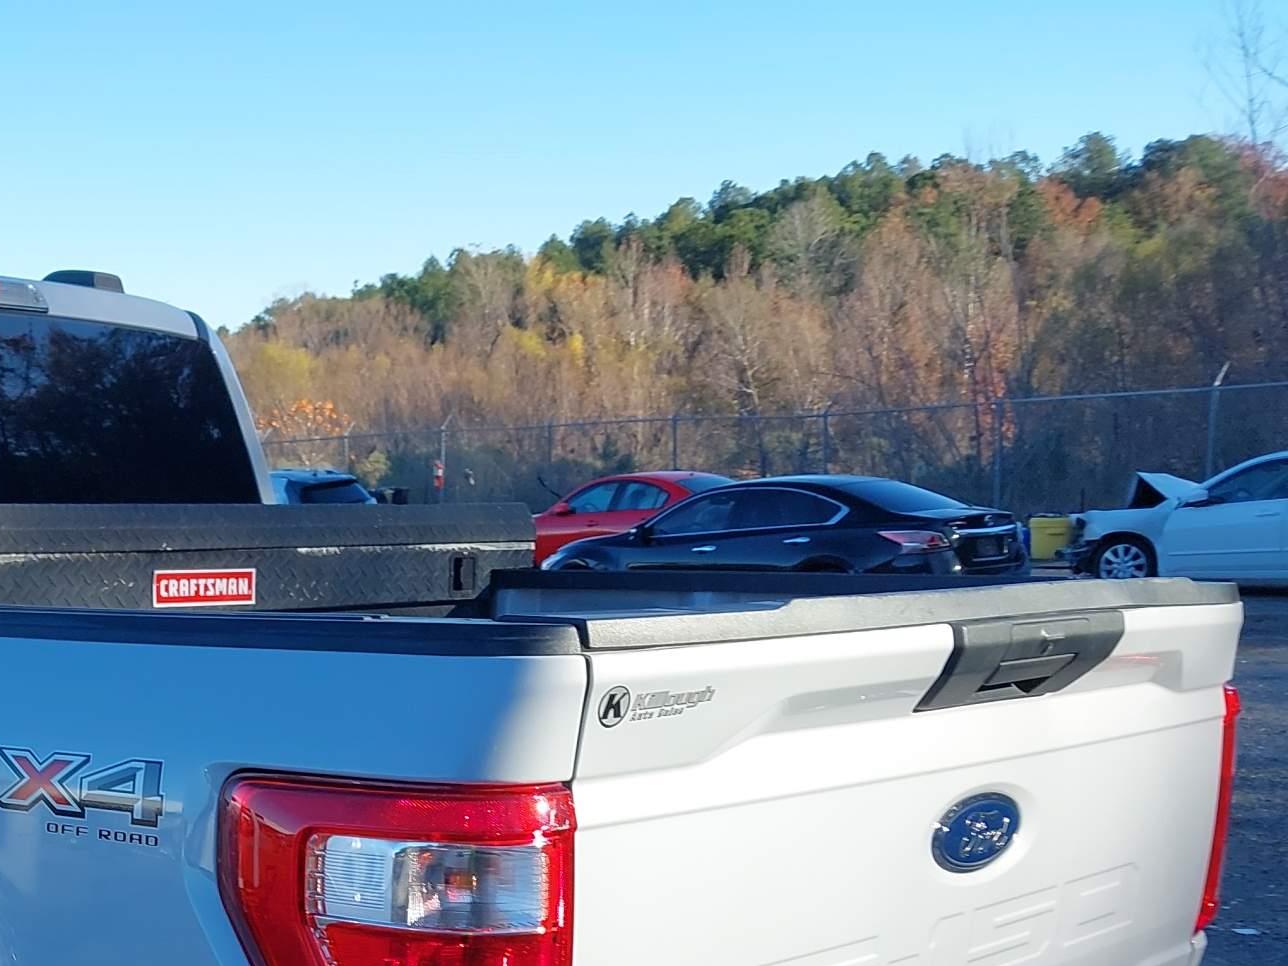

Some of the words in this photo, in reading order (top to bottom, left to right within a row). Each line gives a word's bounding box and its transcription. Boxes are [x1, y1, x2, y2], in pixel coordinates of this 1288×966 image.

[159, 577, 249, 597] CRAFTSMAN
[46, 822, 89, 837] OFF
[98, 829, 158, 847] ROAD
